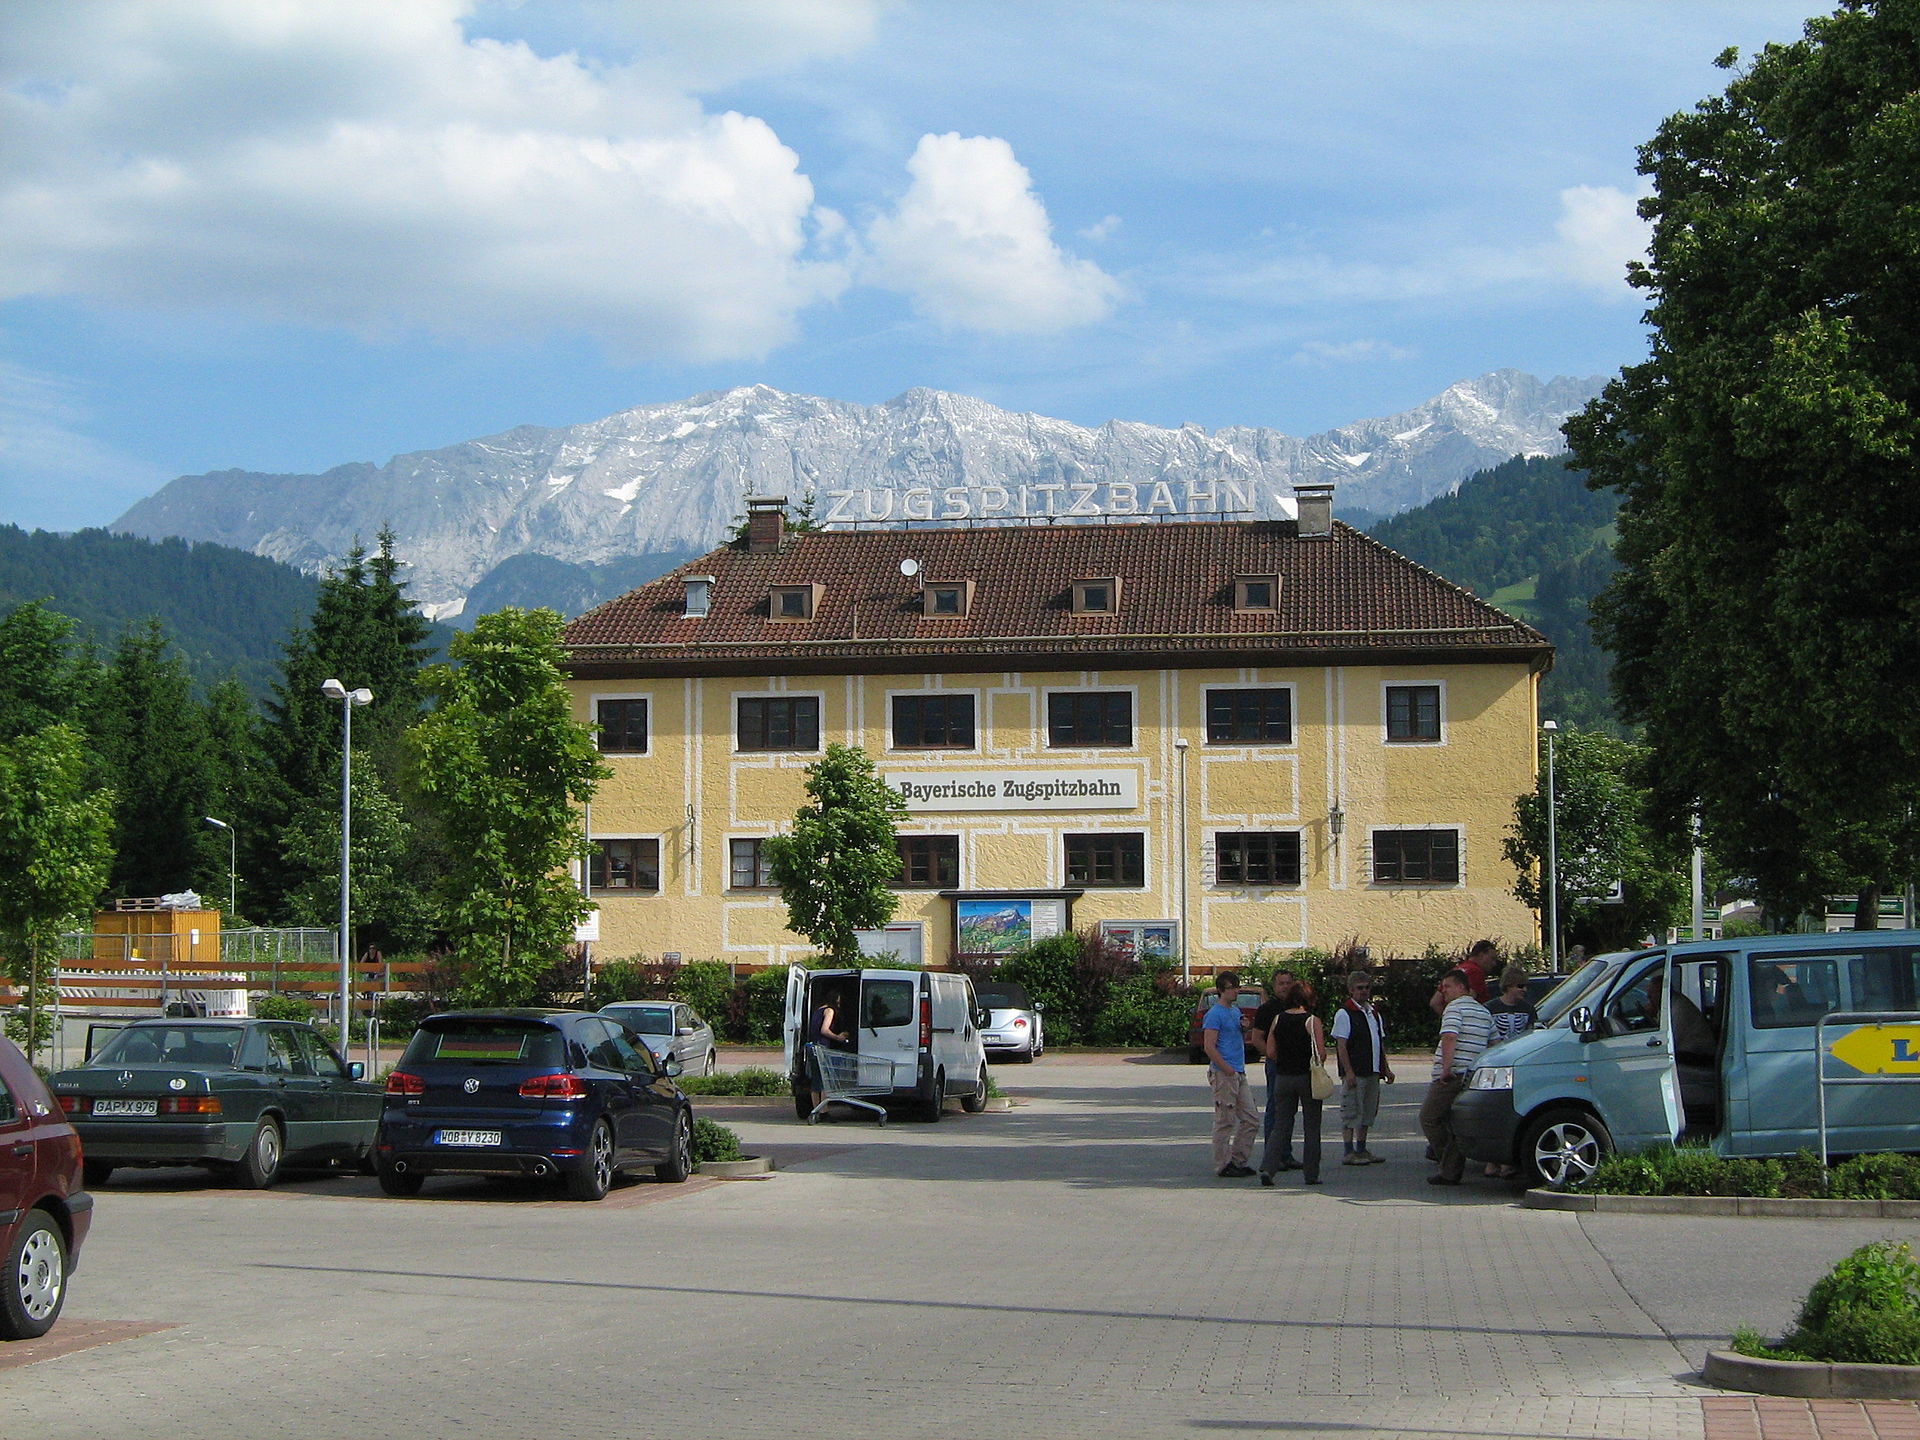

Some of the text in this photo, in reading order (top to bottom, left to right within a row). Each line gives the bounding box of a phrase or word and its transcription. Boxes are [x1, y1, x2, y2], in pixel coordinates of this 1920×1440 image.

[826, 480, 1256, 522] ZUGSPITZBAHN
[900, 779, 1121, 802] Bayerische Zugspitzbahn
[96, 1101, 155, 1113] GAP X 976
[441, 1131, 460, 1143] WOB
[475, 1132, 500, 1144] 8230
